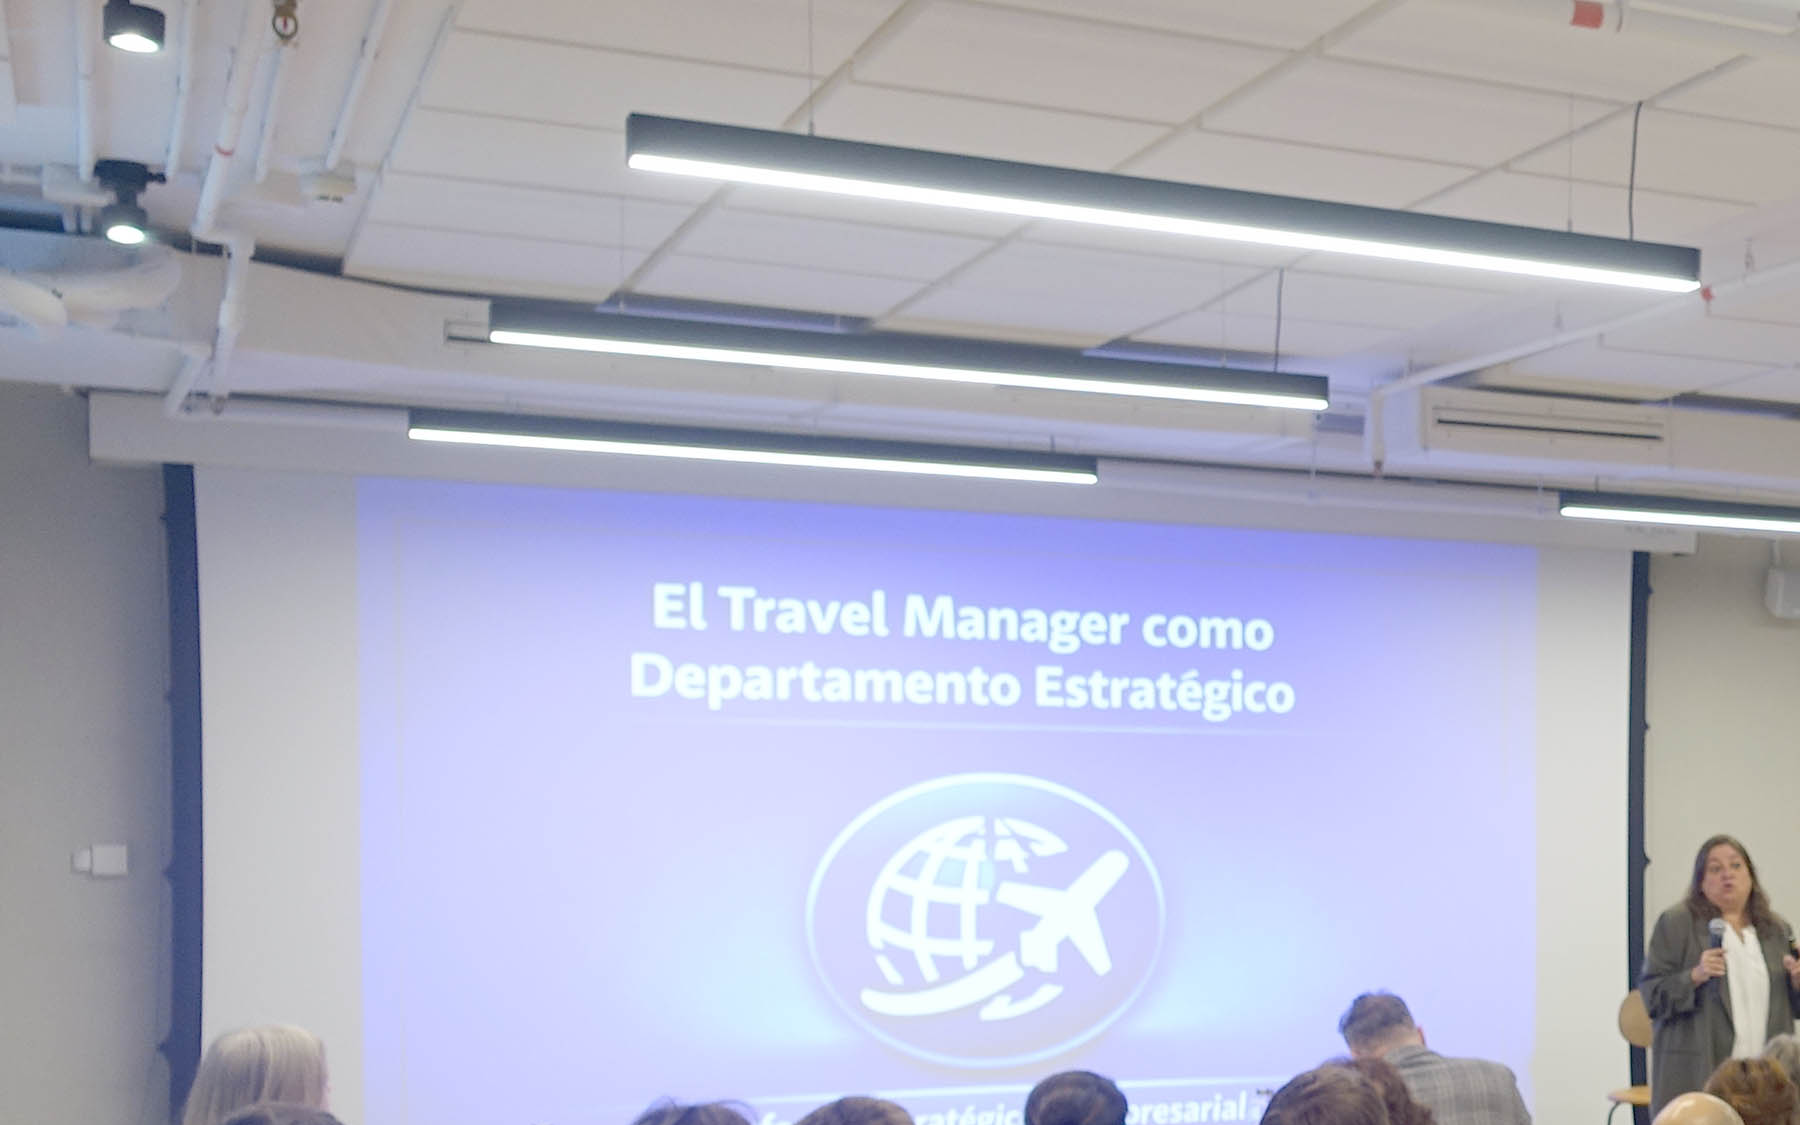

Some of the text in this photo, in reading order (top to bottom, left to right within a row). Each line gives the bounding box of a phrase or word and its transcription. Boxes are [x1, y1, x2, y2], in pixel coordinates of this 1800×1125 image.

[653, 581, 1275, 654] El Travel Manager como
[630, 652, 1296, 722] Departamento Estratégico
